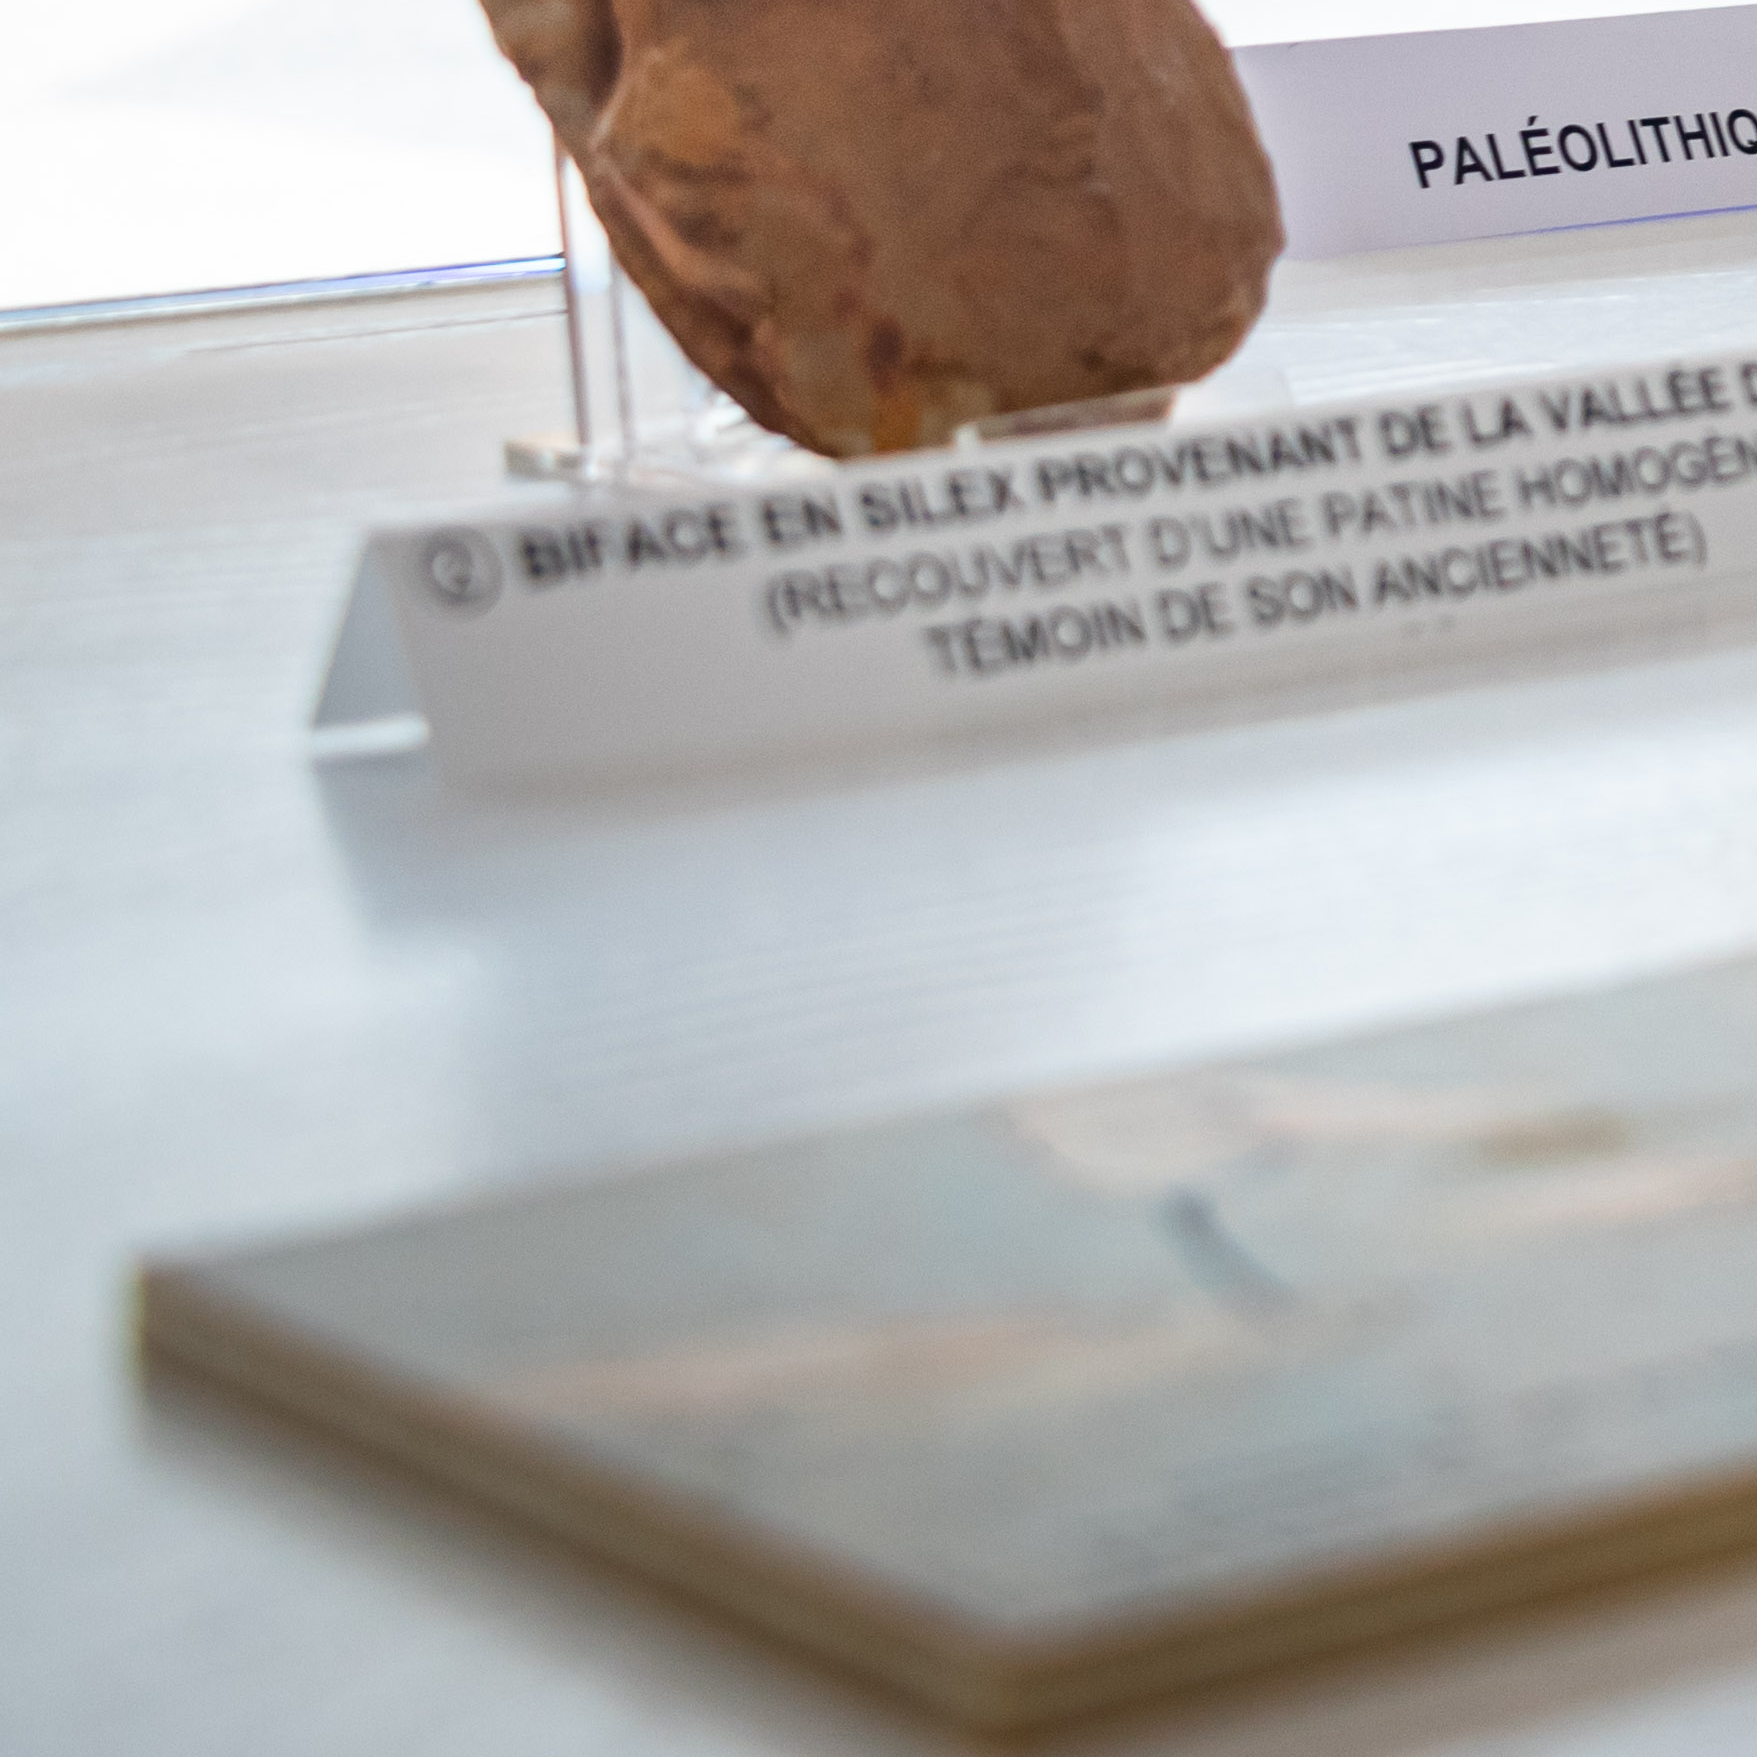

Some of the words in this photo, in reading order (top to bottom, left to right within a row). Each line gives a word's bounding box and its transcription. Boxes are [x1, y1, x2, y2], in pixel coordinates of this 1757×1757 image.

[518, 508, 740, 591] BIFACE
[760, 491, 843, 546] EN
[860, 469, 1022, 533] SILEX
[1036, 415, 1360, 506] PROVENANT
[1379, 402, 1450, 461] DE
[1463, 396, 1530, 447] LA
[1540, 364, 1730, 433] VALLÉE
[763, 523, 1133, 638] (RECOUVERT
[1146, 498, 1313, 570] D'UNE
[1322, 468, 1505, 540] PATINE
[1156, 581, 1237, 645] DE
[1243, 563, 1360, 629] SON
[1372, 510, 1710, 606] ANCIENNETÉ)
